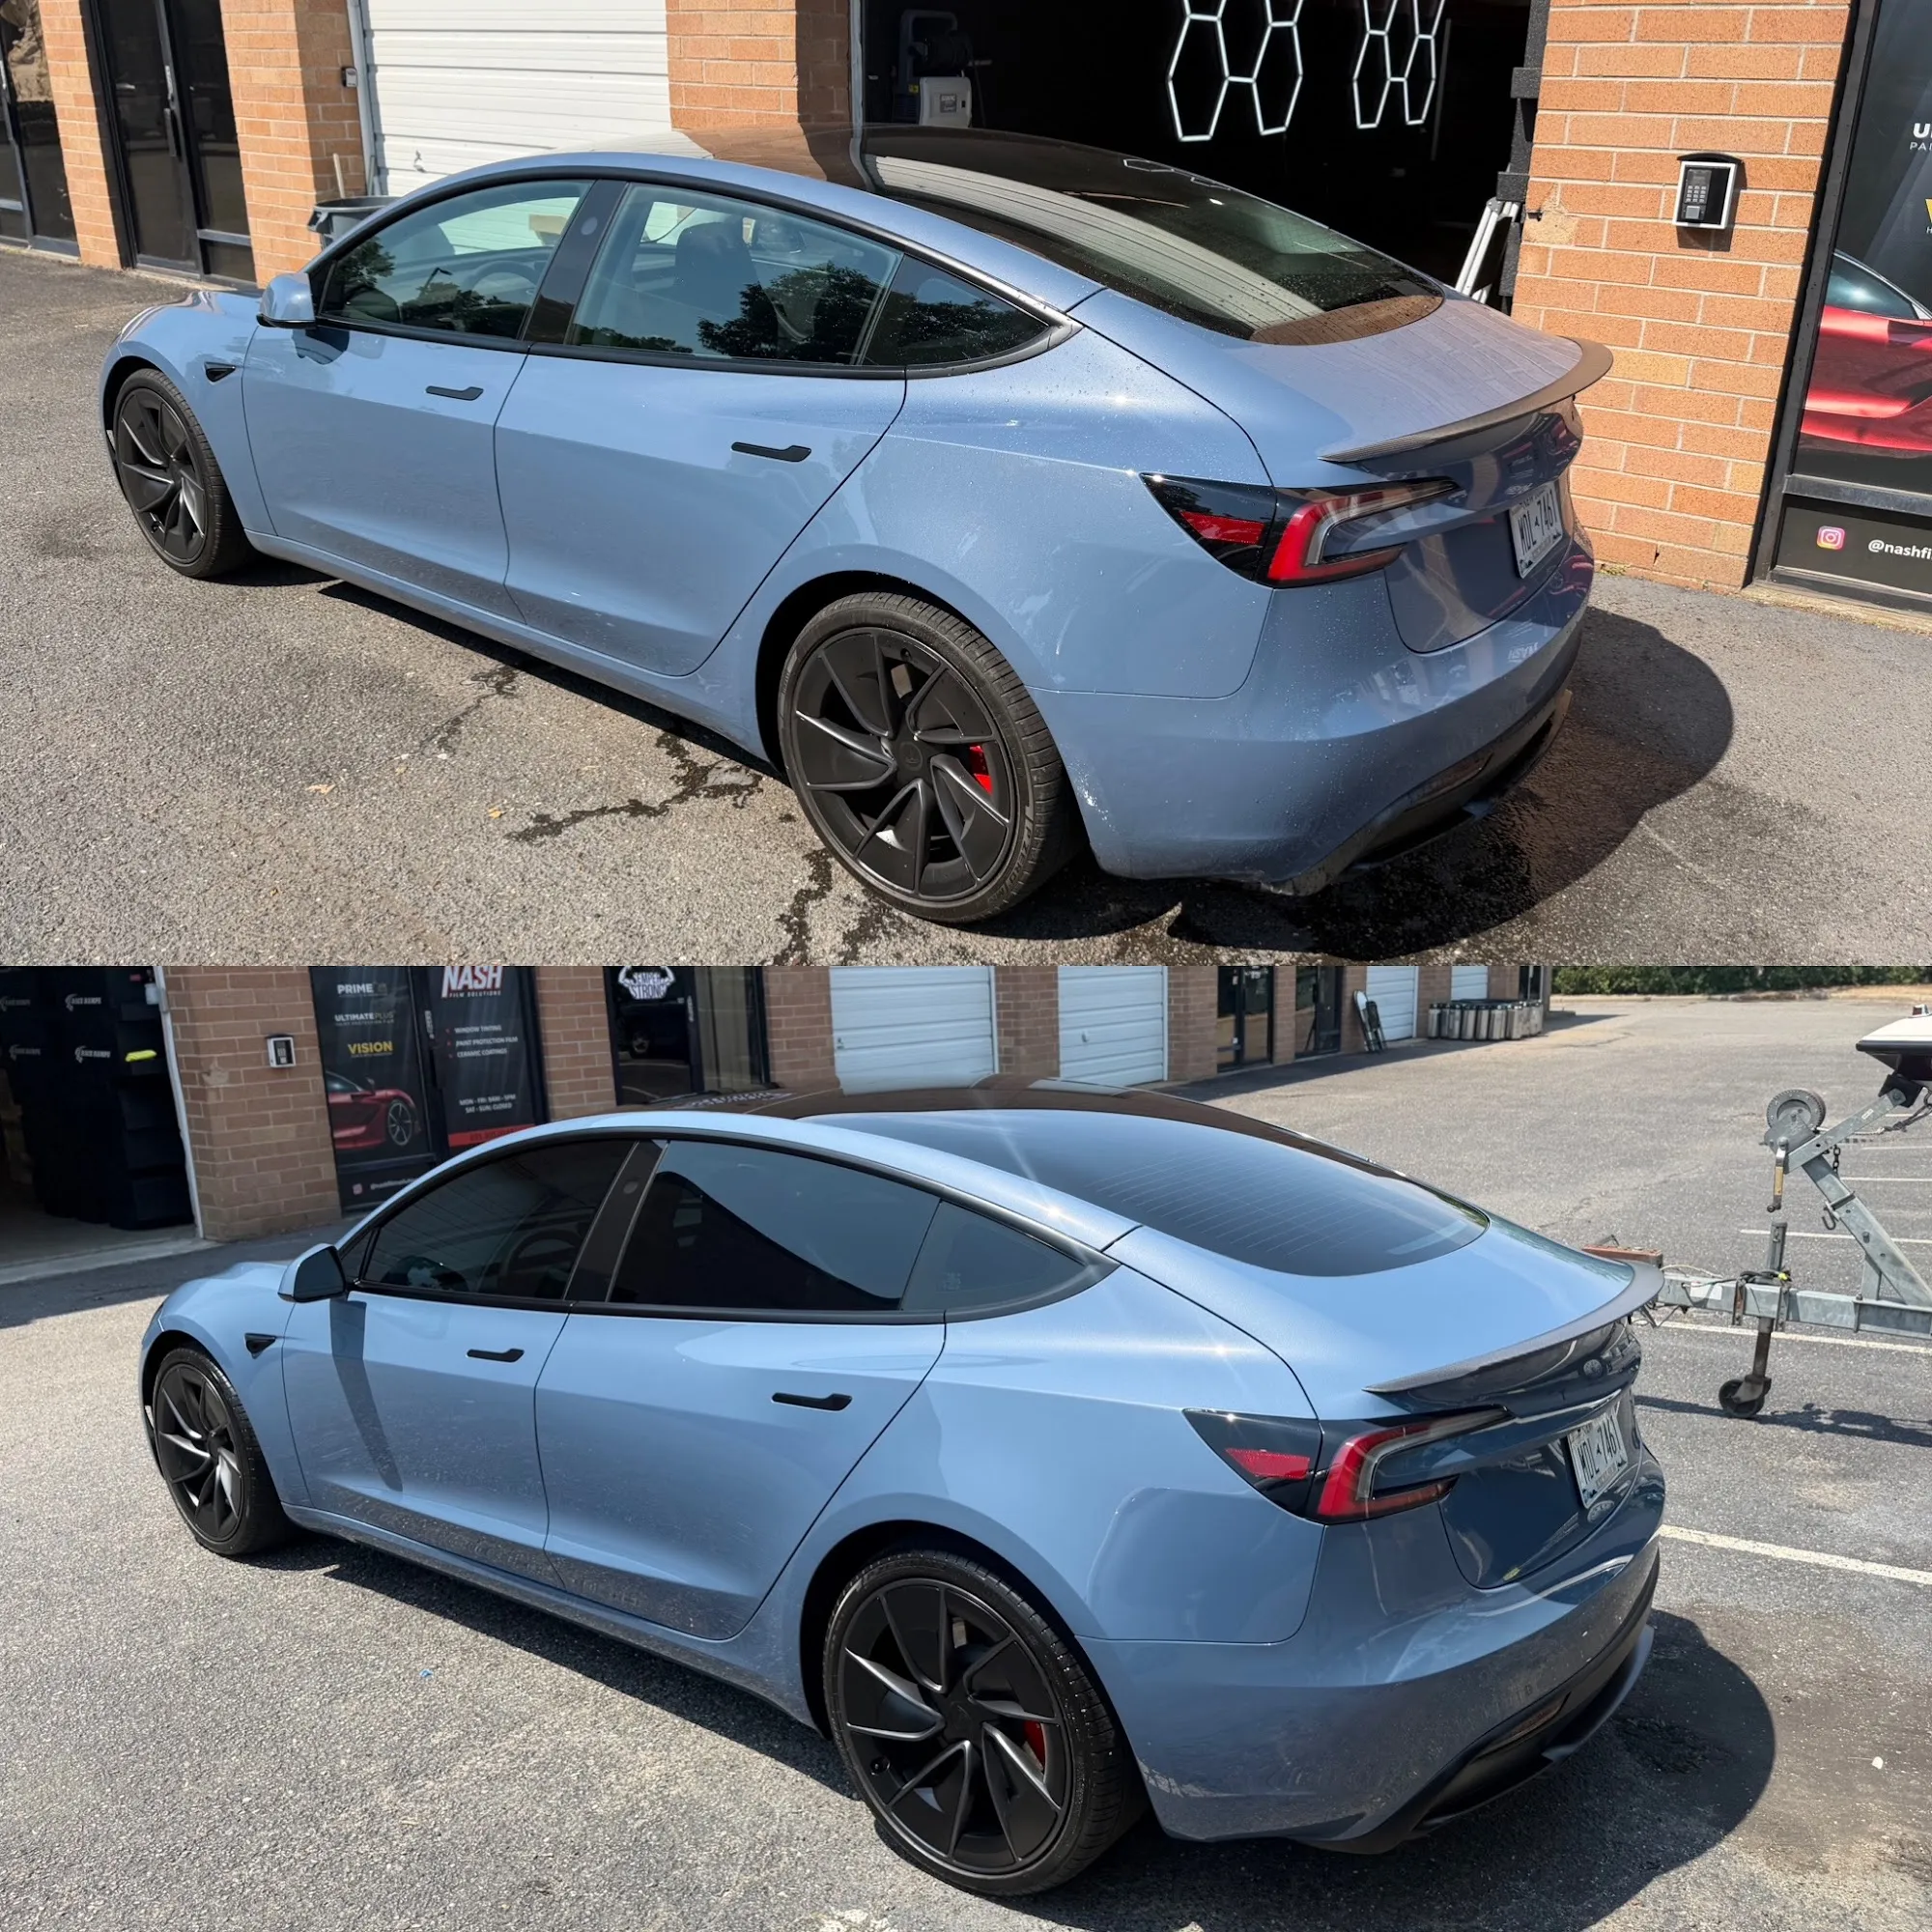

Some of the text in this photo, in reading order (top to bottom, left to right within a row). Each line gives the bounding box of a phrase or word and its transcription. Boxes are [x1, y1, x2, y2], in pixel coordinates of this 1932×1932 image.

[1913, 123, 1932, 138] U
[336, 982, 374, 995] PRIME
[441, 966, 502, 998] NASH
[628, 983, 668, 1000] STRONG
[348, 1040, 393, 1054] VISION
